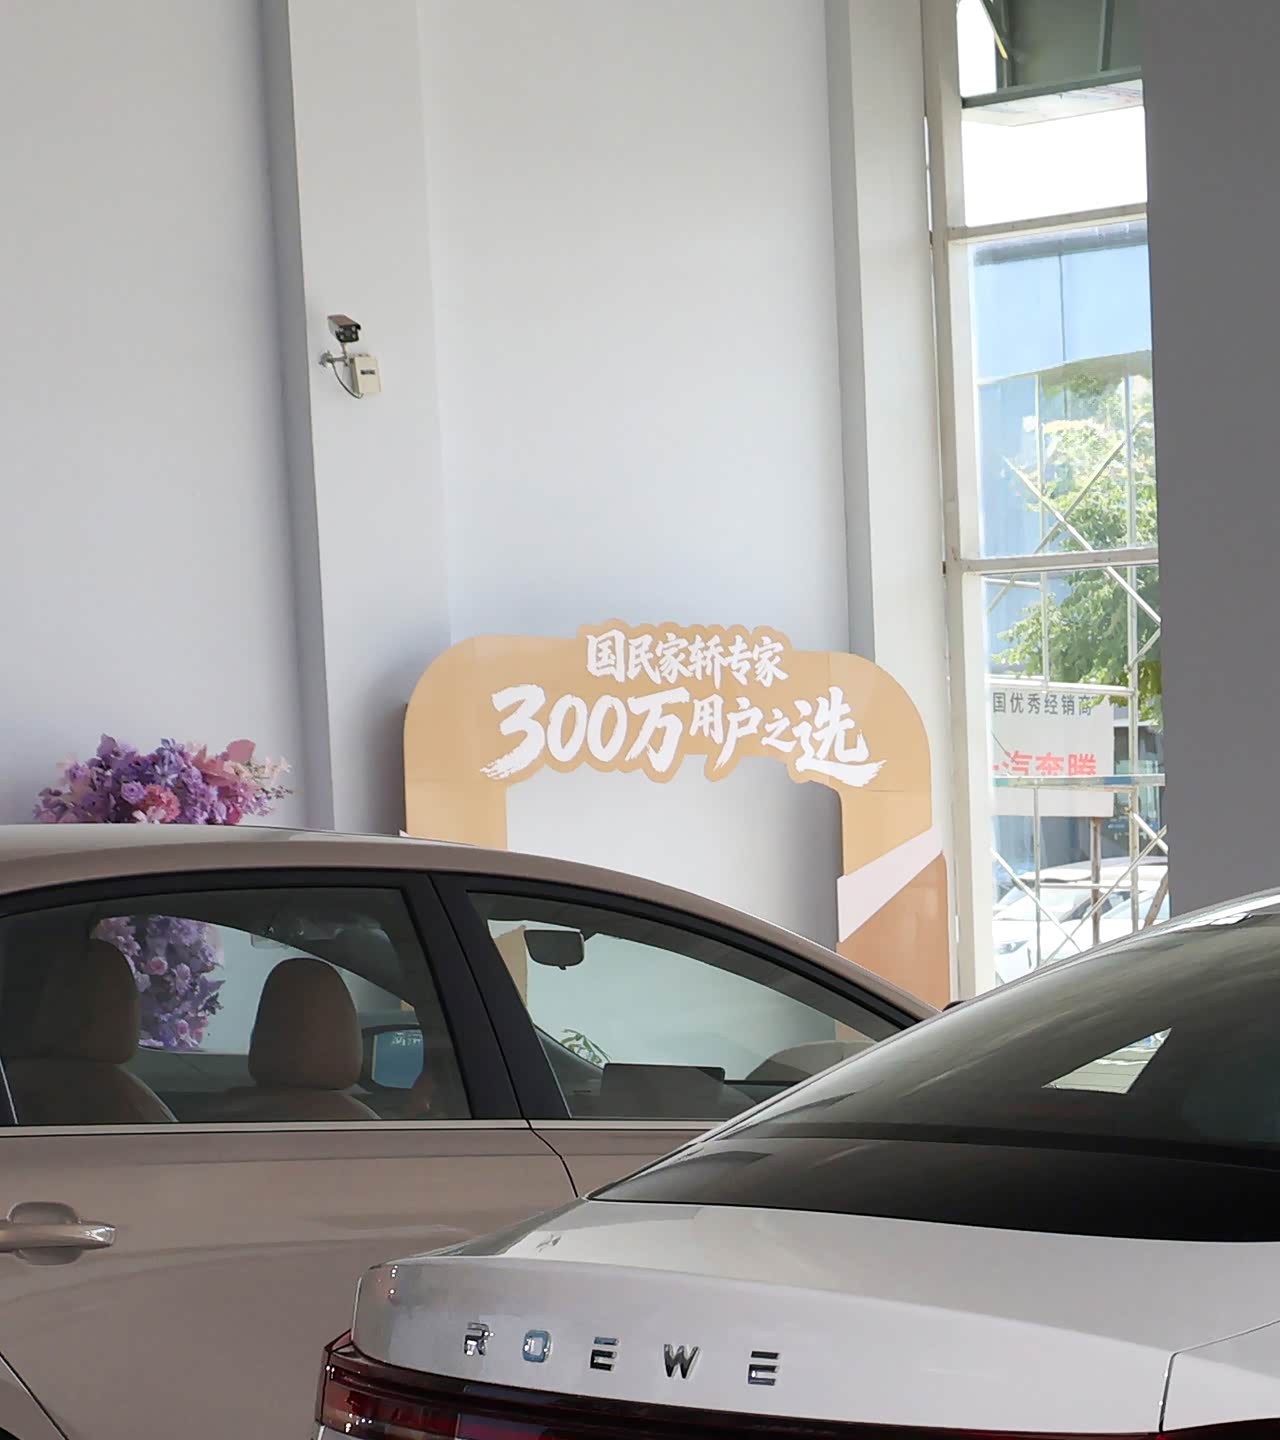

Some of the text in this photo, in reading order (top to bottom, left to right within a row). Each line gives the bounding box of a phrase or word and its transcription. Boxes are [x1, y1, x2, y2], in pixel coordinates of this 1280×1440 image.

[586, 629, 789, 688] 国民家轿专家
[480, 684, 887, 787] 300万用户之选
[992, 751, 1096, 776] 汽奔腾
[462, 1322, 781, 1387] ROEWE
